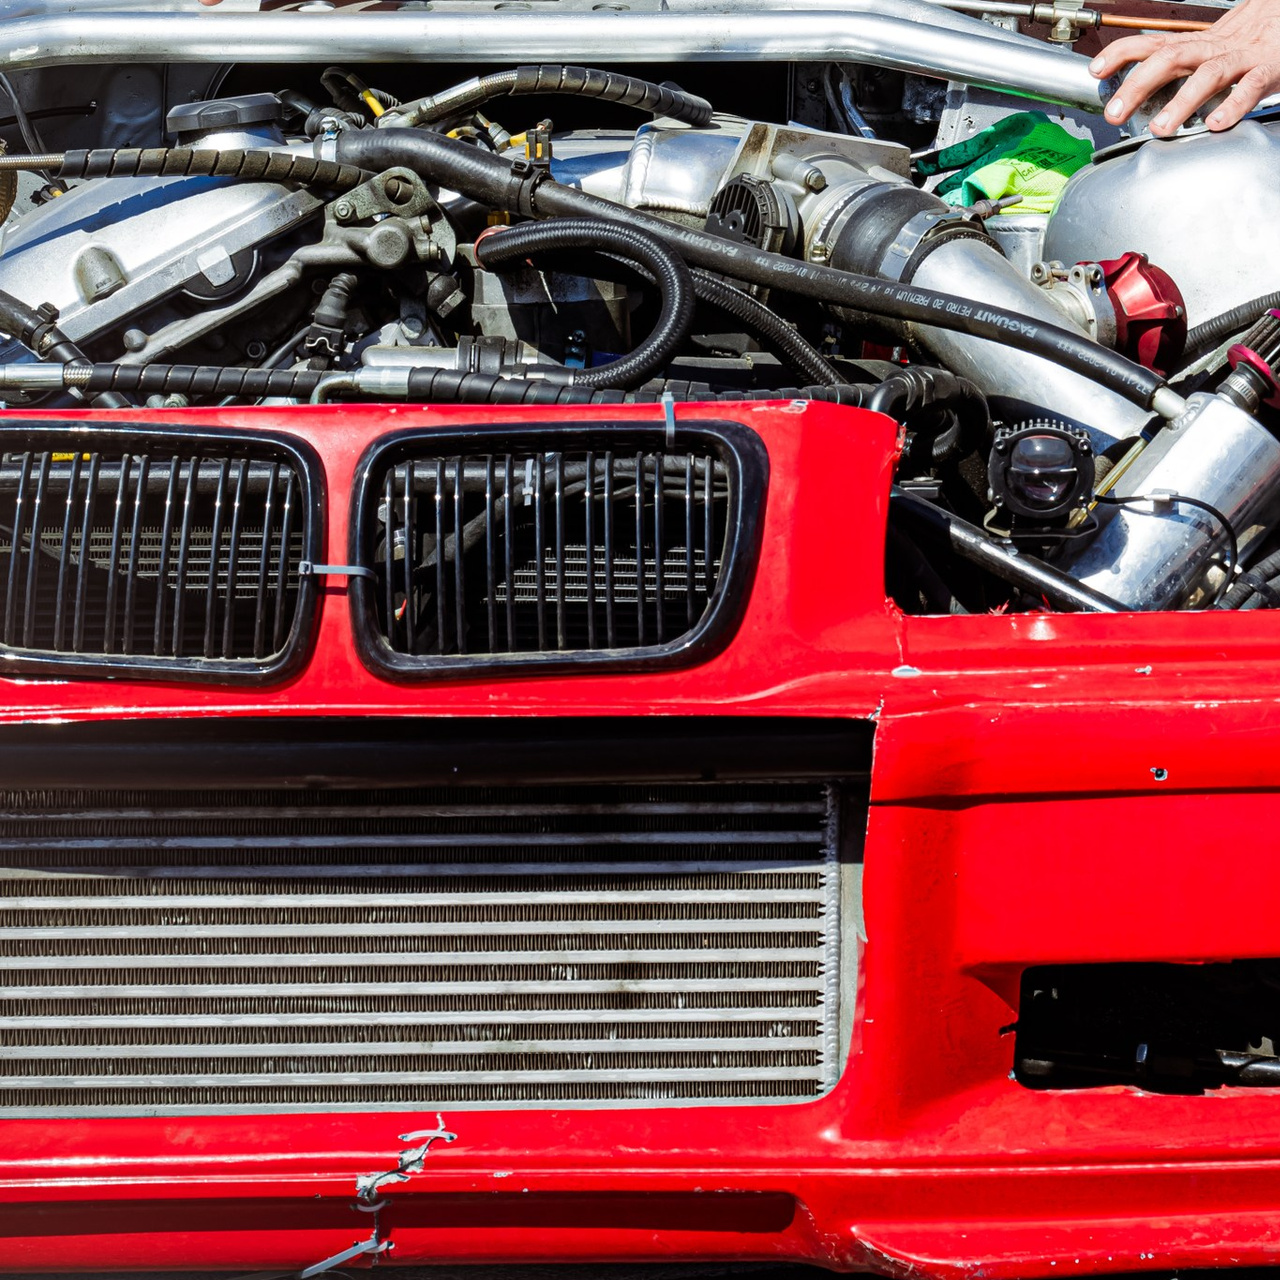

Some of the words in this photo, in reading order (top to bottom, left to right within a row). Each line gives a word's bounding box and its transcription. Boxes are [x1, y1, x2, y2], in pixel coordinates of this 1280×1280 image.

[590, 199, 632, 220] PREMIUM
[633, 214, 645, 226] 20
[647, 219, 676, 235] PETRO
[677, 229, 739, 258] FAGUMIT
[895, 288, 931, 307] PREMIUM
[932, 297, 944, 310] 20
[945, 301, 972, 317] PETRO
[973, 311, 1038, 340] FAGUMIT
